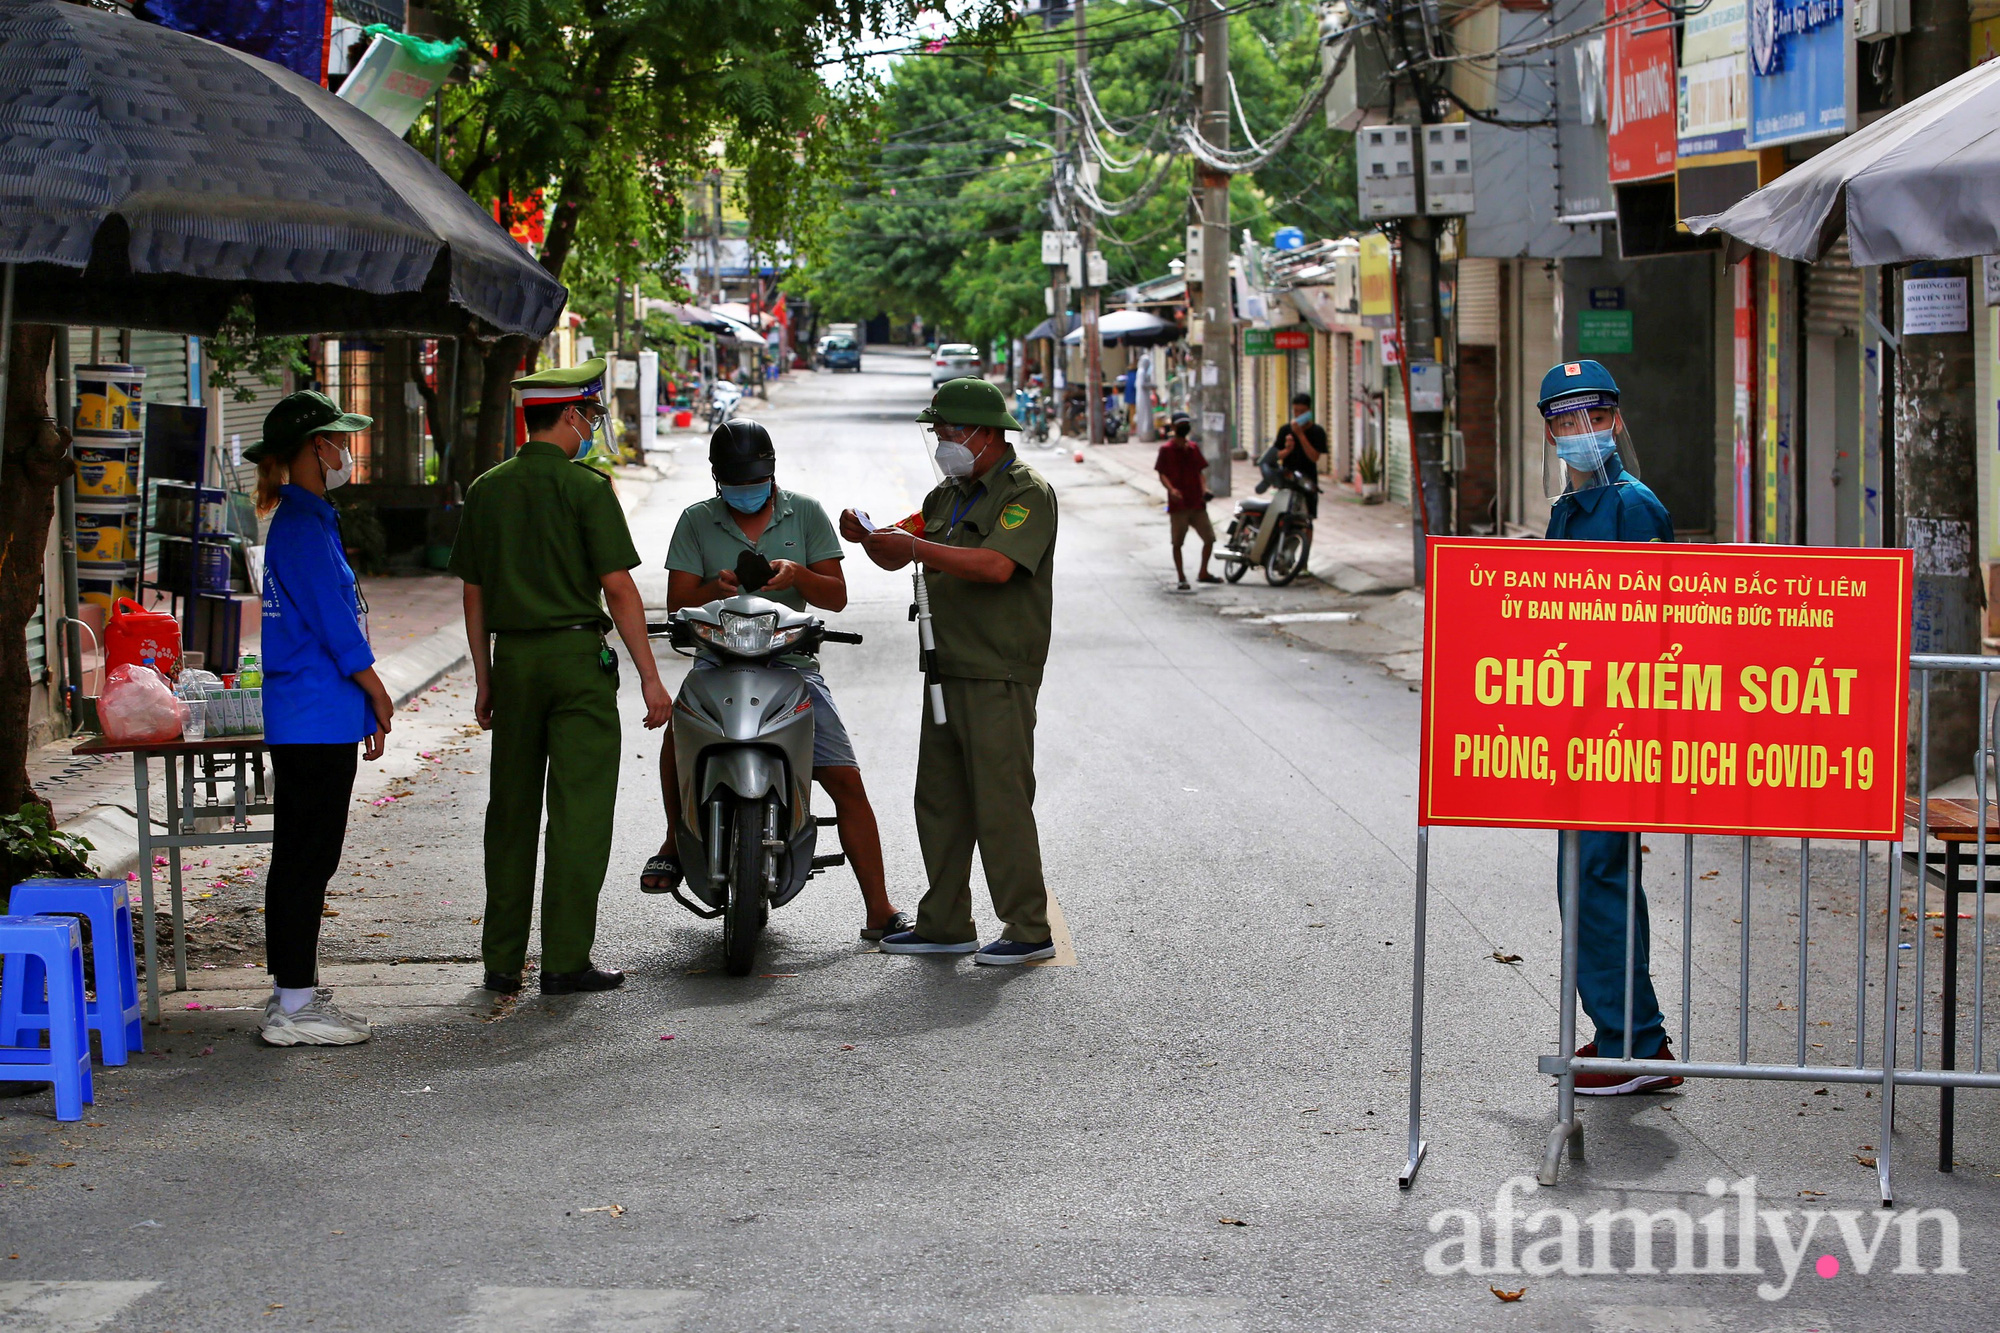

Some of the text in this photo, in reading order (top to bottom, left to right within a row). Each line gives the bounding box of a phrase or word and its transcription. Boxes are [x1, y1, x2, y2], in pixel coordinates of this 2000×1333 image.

[1778, 8, 1791, 34] Anh
[1917, 280, 1943, 290] PHÒNG
[1944, 281, 1961, 289] CHO
[1921, 292, 1940, 301] VIÊN
[81, 453, 103, 462] Dulux
[77, 520, 98, 528] Dulux
[1469, 562, 1867, 597] ỦY BAN NHÂN DÂN QUẬN BẮC TỪ LIÊM
[1501, 593, 1834, 628] ỦY BAN NHÂN DÂN PHƯỜNG ĐỨC THẮNG
[1474, 643, 1858, 716] CHỐT KIỂM SOÁT
[1453, 723, 1874, 795] PHÒNG, CHỐNG DỊCH COVID-19
